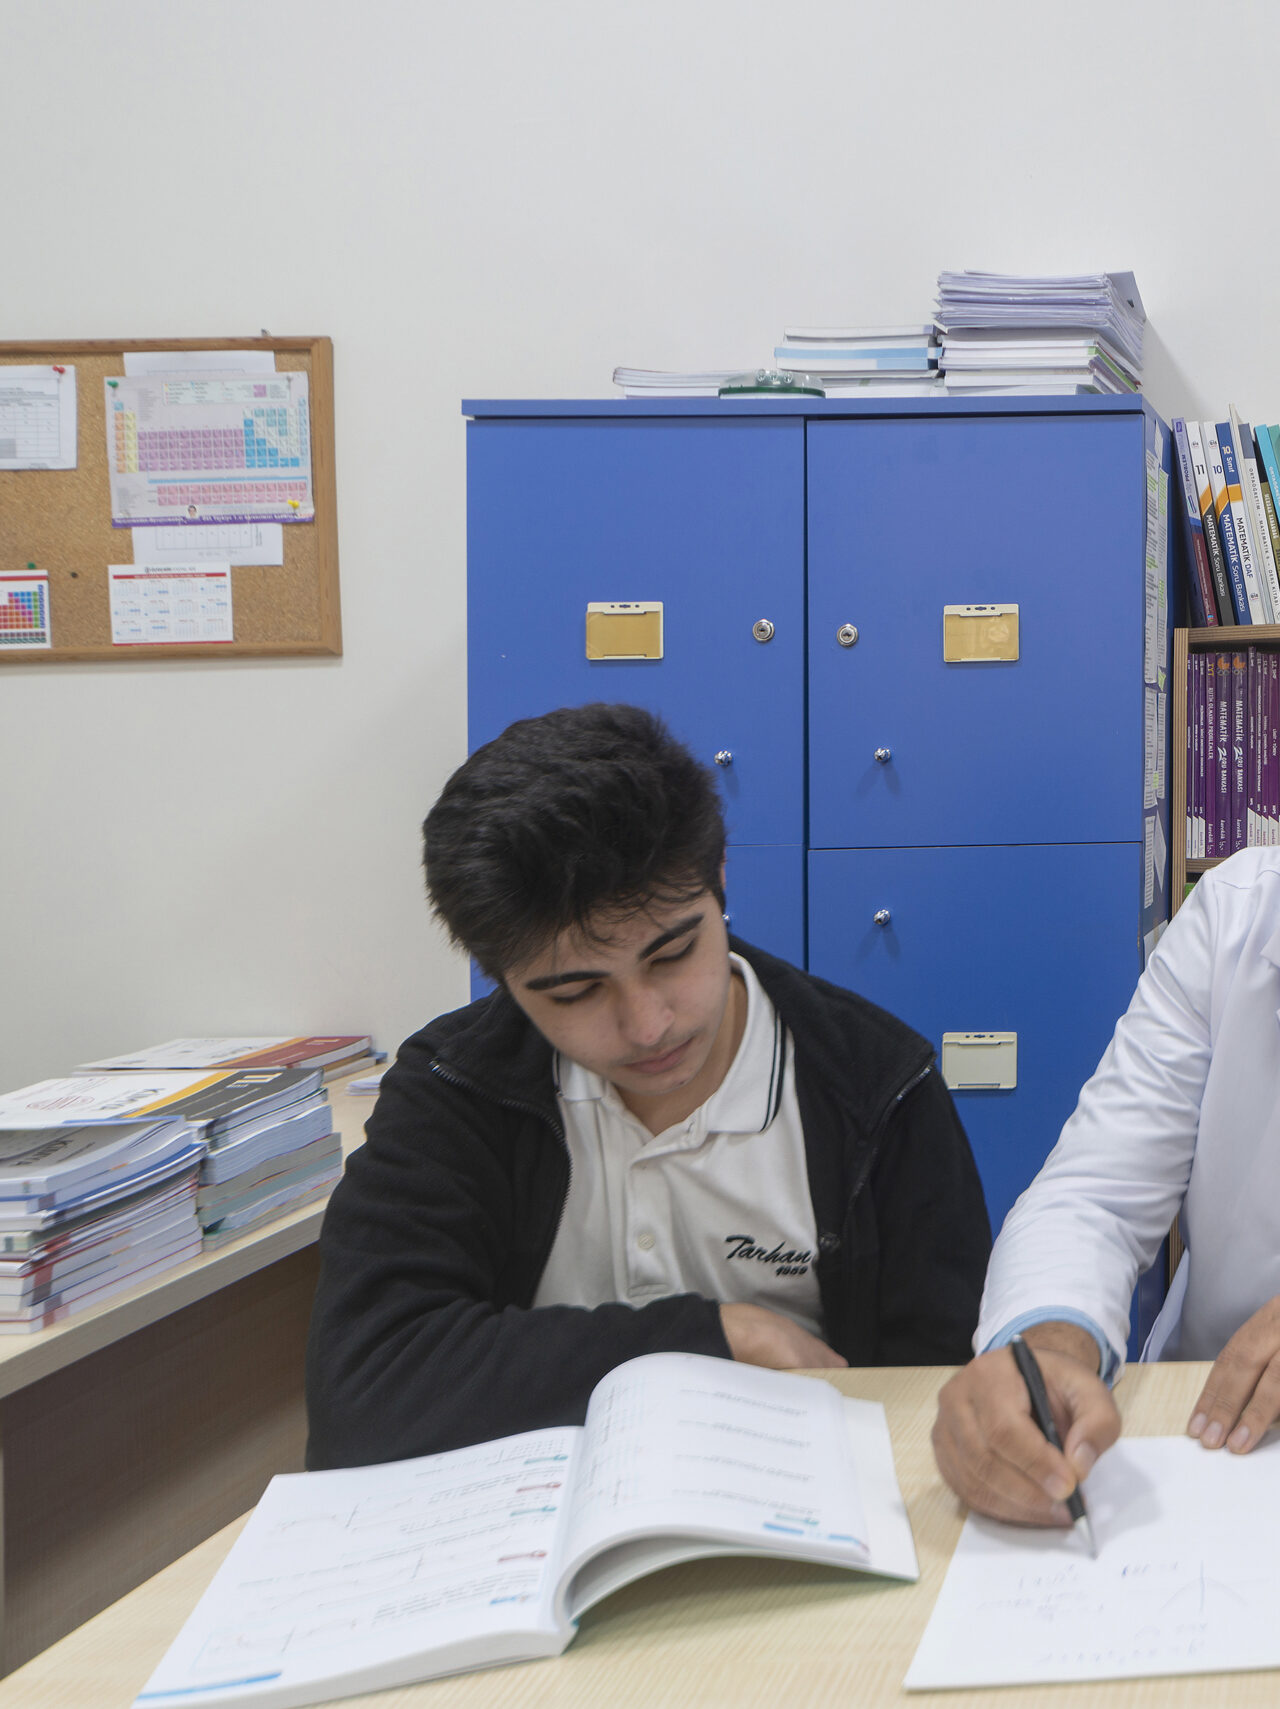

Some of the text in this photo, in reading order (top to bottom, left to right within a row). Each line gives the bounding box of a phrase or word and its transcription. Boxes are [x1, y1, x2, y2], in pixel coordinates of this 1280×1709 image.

[1195, 464, 1205, 475] 11
[1212, 465, 1222, 474] 10
[1226, 456, 1236, 473] Sınıf
[1206, 514, 1226, 597] MATEMATİK Soru Bankası
[1222, 514, 1246, 612] MATEMATİK Soru Bankası
[1236, 518, 1254, 578] MATEMATİK DAF
[1259, 520, 1269, 557] MATEMATİK
[1272, 586, 1280, 606] KİTABI
[1220, 701, 1228, 742] MATEMATİK
[1236, 700, 1244, 742] MATEMATİK
[725, 1234, 812, 1264] Tarhan
